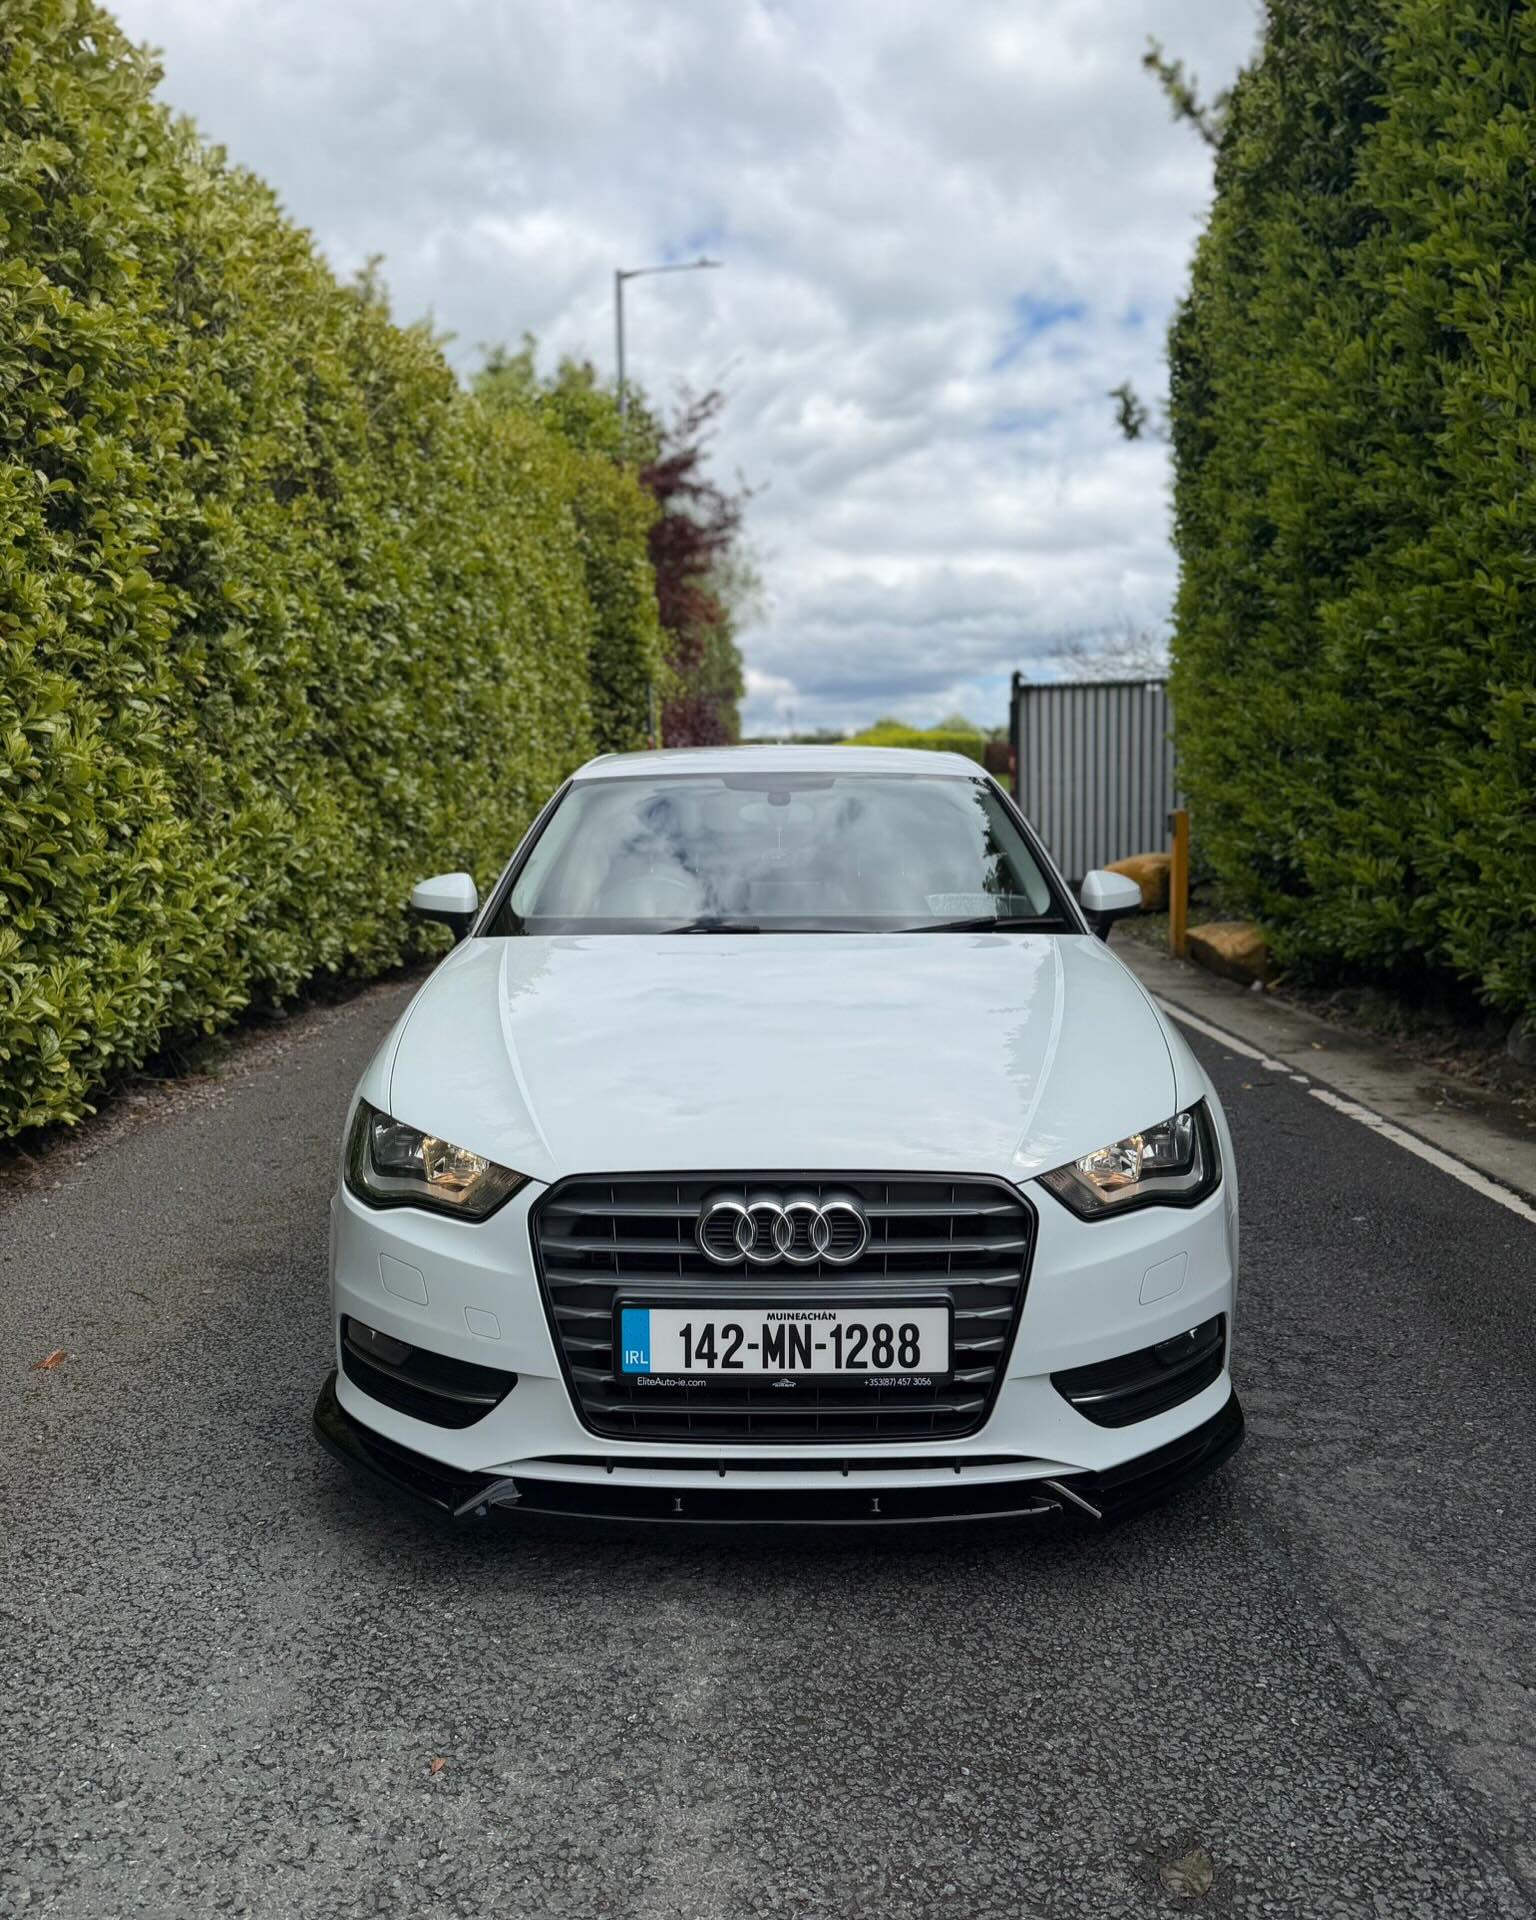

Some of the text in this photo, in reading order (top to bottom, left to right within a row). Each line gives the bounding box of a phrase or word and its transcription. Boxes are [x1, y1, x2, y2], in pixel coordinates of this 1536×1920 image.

[766, 1311, 837, 1321] MUINEACHÁN
[679, 1323, 920, 1369] 142-MN-1288
[625, 1350, 648, 1365] IRL
[637, 1377, 706, 1387] EliteAuto-ie.com
